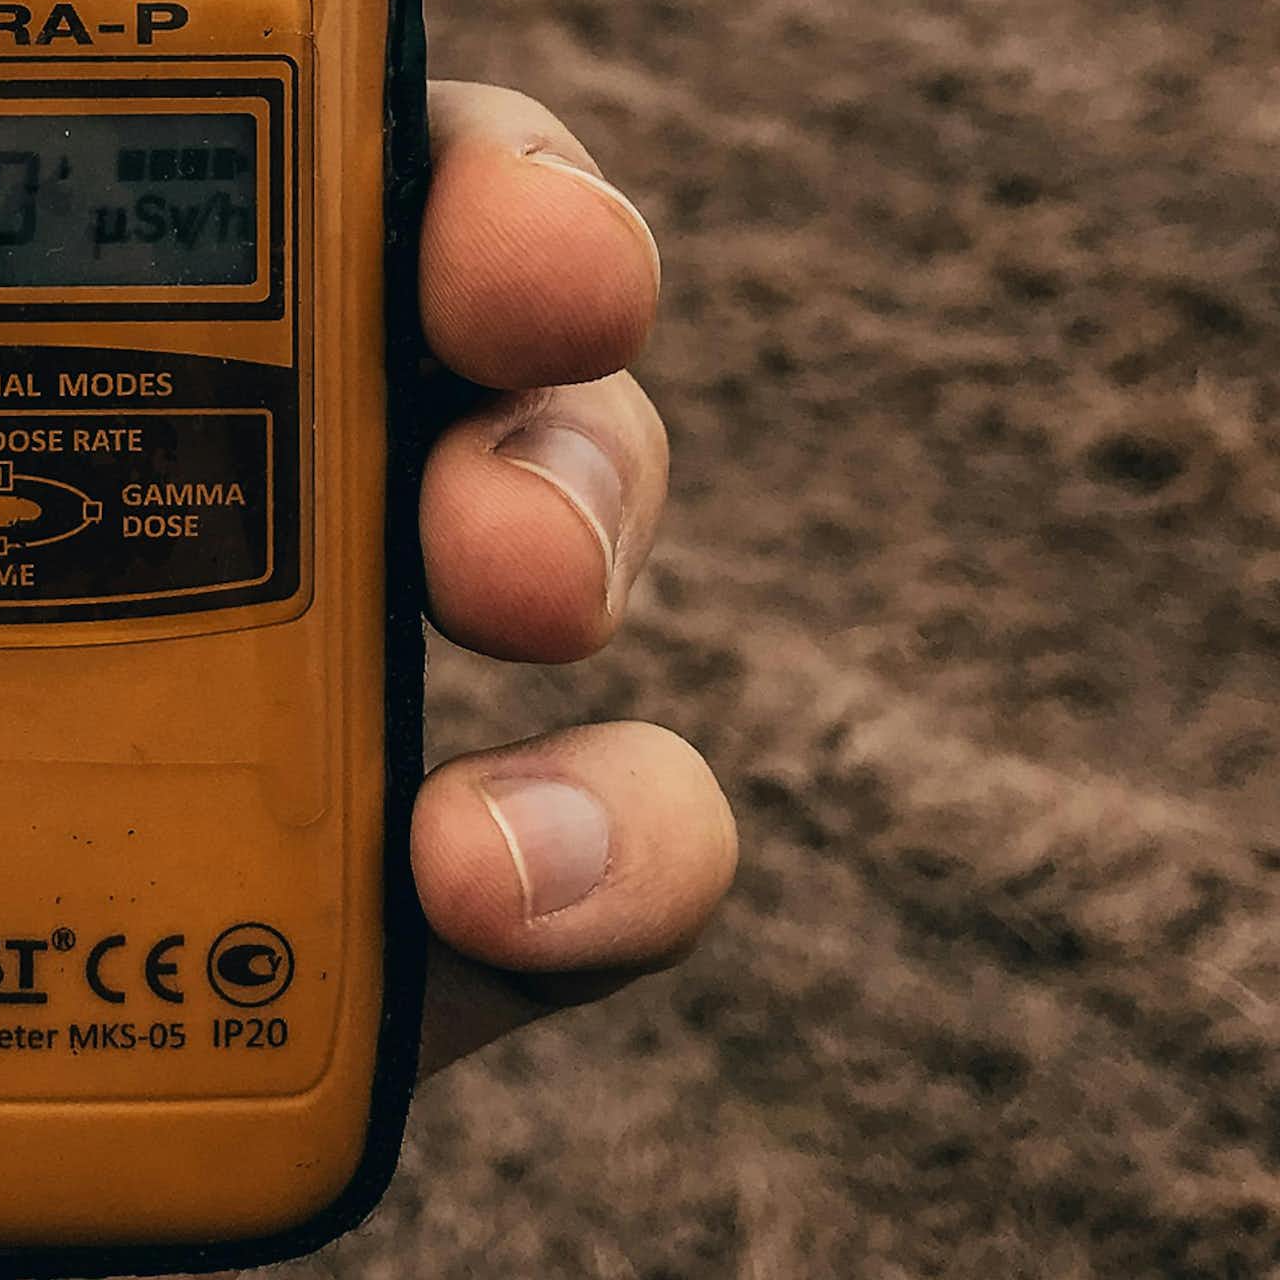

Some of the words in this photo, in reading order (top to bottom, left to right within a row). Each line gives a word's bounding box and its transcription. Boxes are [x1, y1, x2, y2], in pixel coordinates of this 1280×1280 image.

[58, 372, 174, 397] MODES
[73, 429, 144, 451] RATE
[121, 484, 246, 506] GAMMA
[123, 516, 199, 538] DOSE
[69, 1022, 187, 1050] MKS-05
[213, 1018, 289, 1048] IP20
